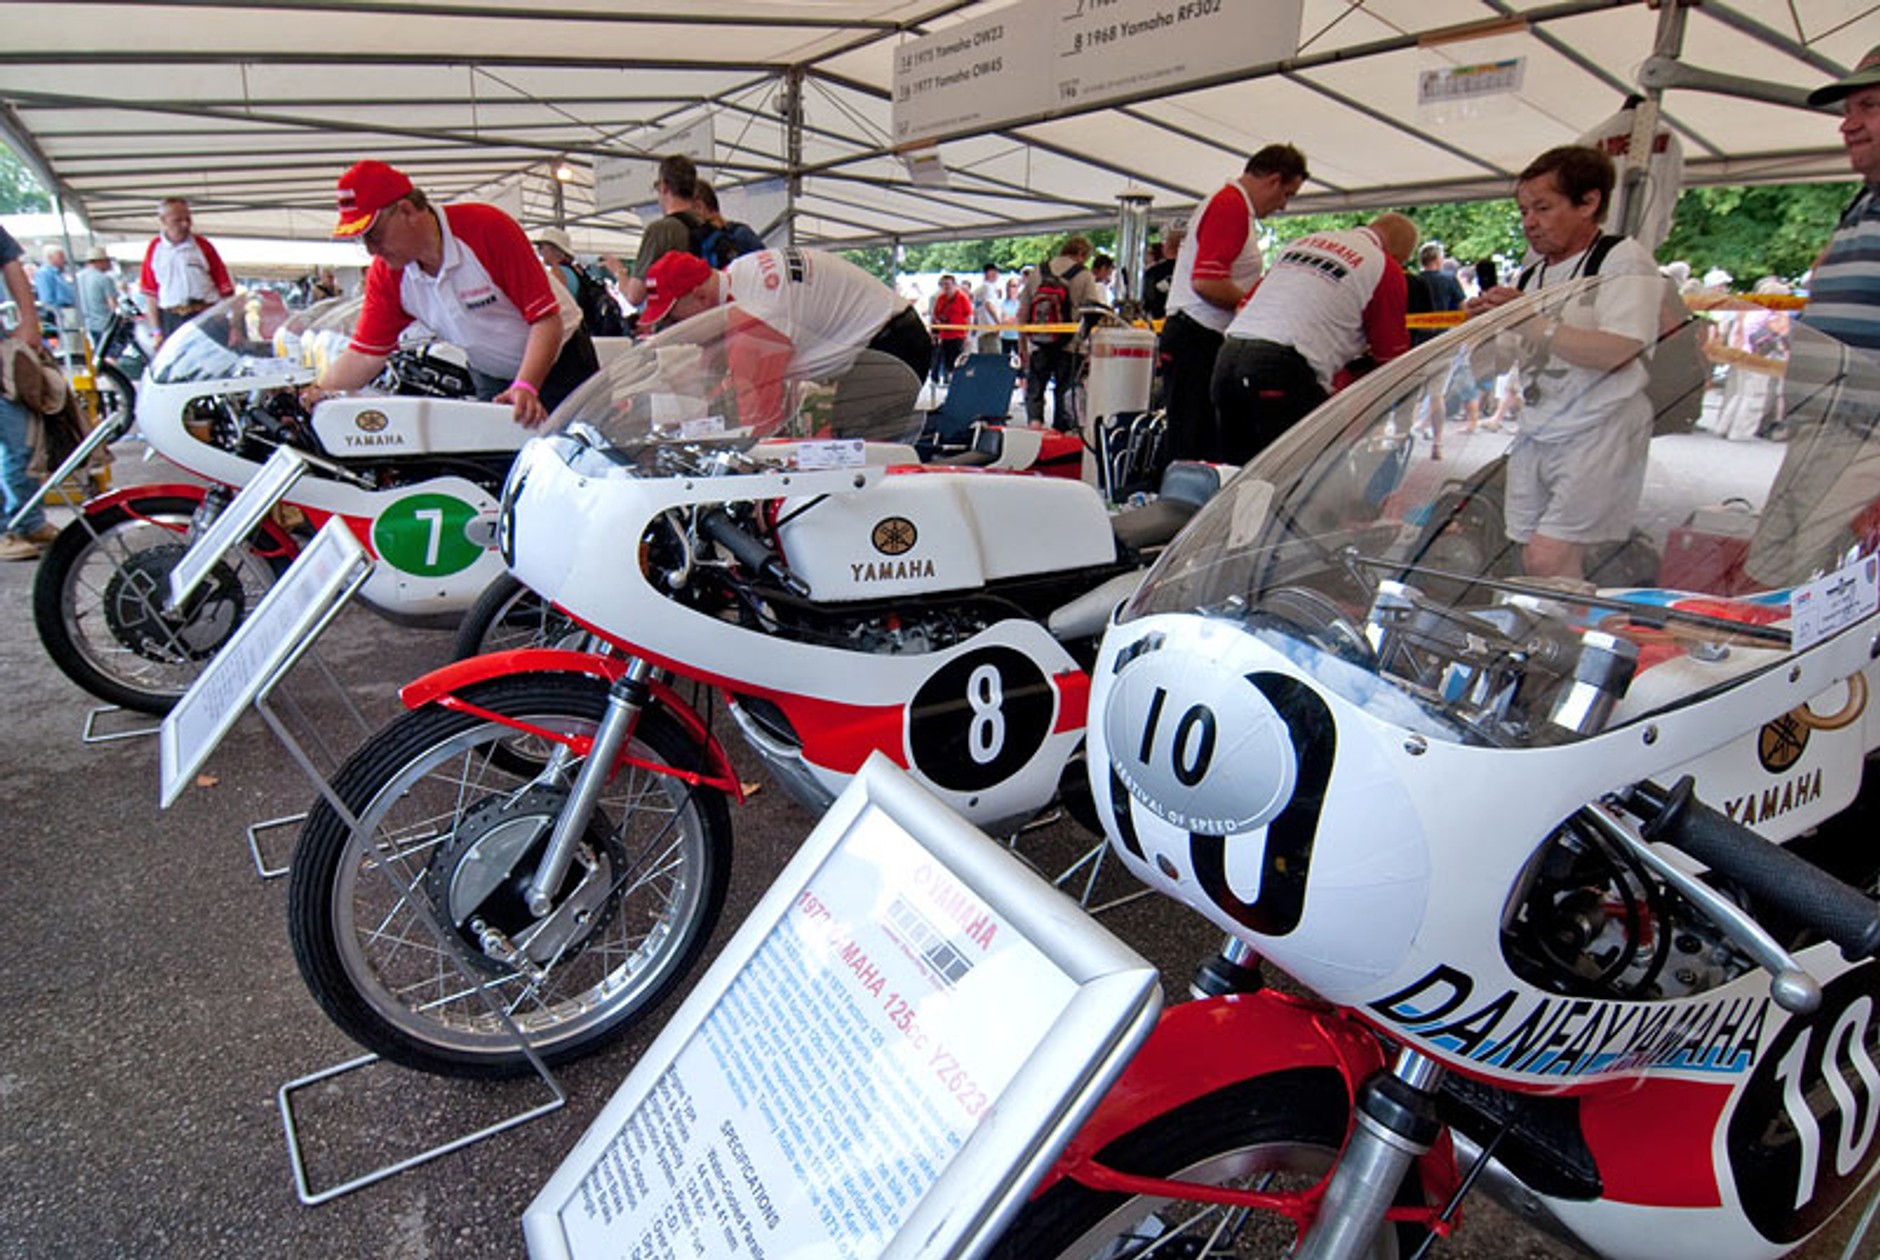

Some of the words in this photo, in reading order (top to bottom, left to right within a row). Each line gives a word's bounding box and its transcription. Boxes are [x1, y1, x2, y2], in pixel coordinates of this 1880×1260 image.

[936, 37, 972, 57] Yamaha
[1074, 33, 1082, 49] 8
[1086, 26, 1117, 47] 1968
[1120, 14, 1174, 37] Yamaha
[1177, 0, 1222, 22] RF302
[935, 68, 970, 87] Yamaha
[345, 434, 404, 447] YAMAHA
[414, 508, 443, 566] 7
[487, 522, 498, 539] 7
[851, 559, 935, 582] YAMAHA
[967, 663, 1006, 765] 8
[1139, 686, 1217, 787] 10
[1724, 767, 1822, 827] YAMAHA
[1190, 818, 1238, 833] SPEED
[1776, 994, 1880, 1210] 10
[720, 1120, 779, 1229] SPECIFICATIONS
